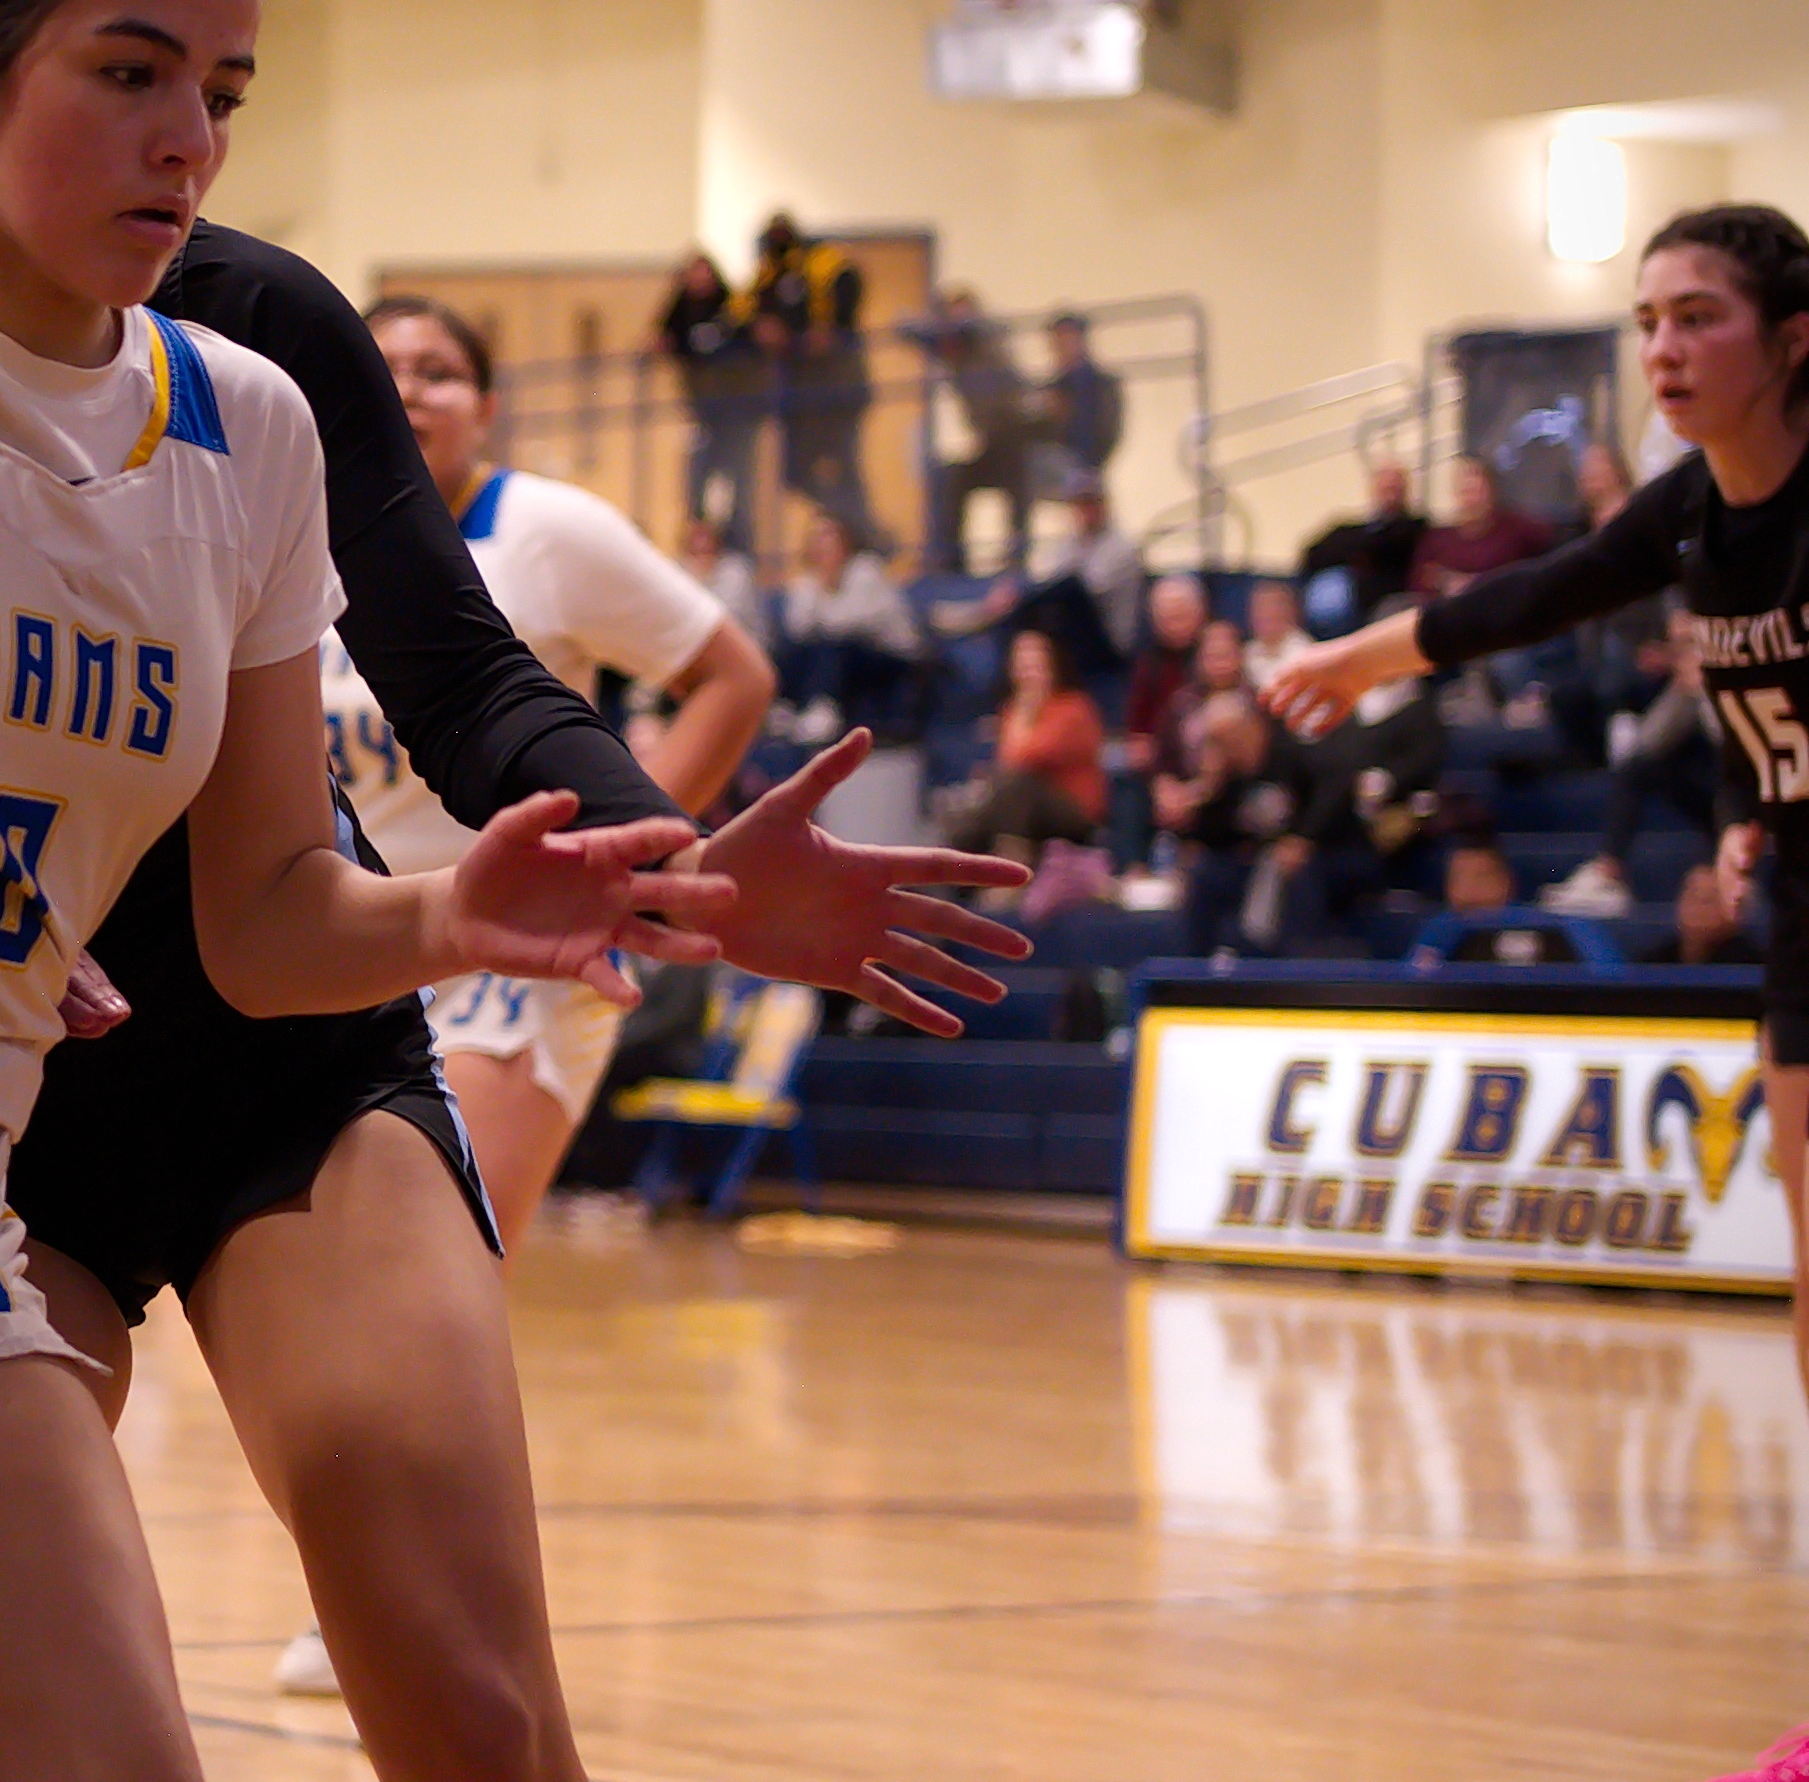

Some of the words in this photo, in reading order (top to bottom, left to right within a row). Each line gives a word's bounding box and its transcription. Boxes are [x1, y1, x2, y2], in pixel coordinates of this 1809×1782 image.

[1717, 686, 1809, 804] 15
[1263, 1058, 1623, 1169] CUBA
[1219, 1171, 1398, 1233] HIGH
[1411, 1181, 1695, 1251] SCHOOL
